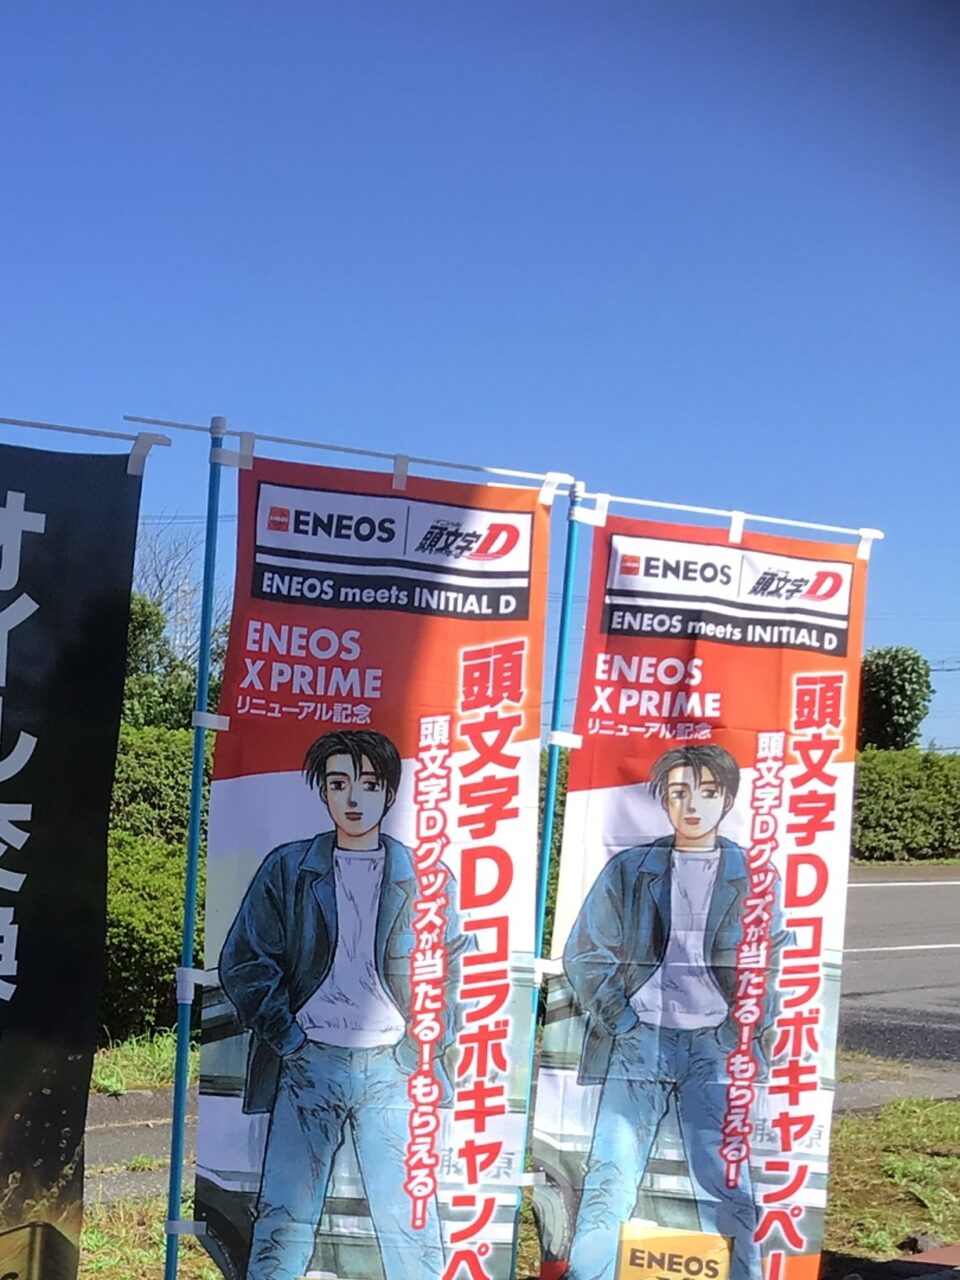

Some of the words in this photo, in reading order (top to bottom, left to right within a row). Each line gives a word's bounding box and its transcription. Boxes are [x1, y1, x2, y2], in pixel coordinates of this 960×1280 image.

[293, 510, 396, 543] ENEOS
[643, 556, 731, 586] ENEOS
[262, 572, 334, 601] ENEOS
[340, 585, 408, 605] meets
[414, 586, 492, 615] INITIAL
[499, 595, 517, 614] D
[246, 620, 362, 661] ENEOS
[611, 611, 682, 633] ENEOS
[687, 621, 742, 640] meets
[747, 625, 820, 648] INITIAL
[824, 633, 837, 650] D
[271, 662, 382, 698] PRIME
[595, 654, 703, 686] ENEOS
[236, 695, 372, 724] リニューアル記念
[618, 689, 721, 718] PRIME
[588, 718, 712, 740] リニューアル記念
[629, 1248, 719, 1279] ENEOS
